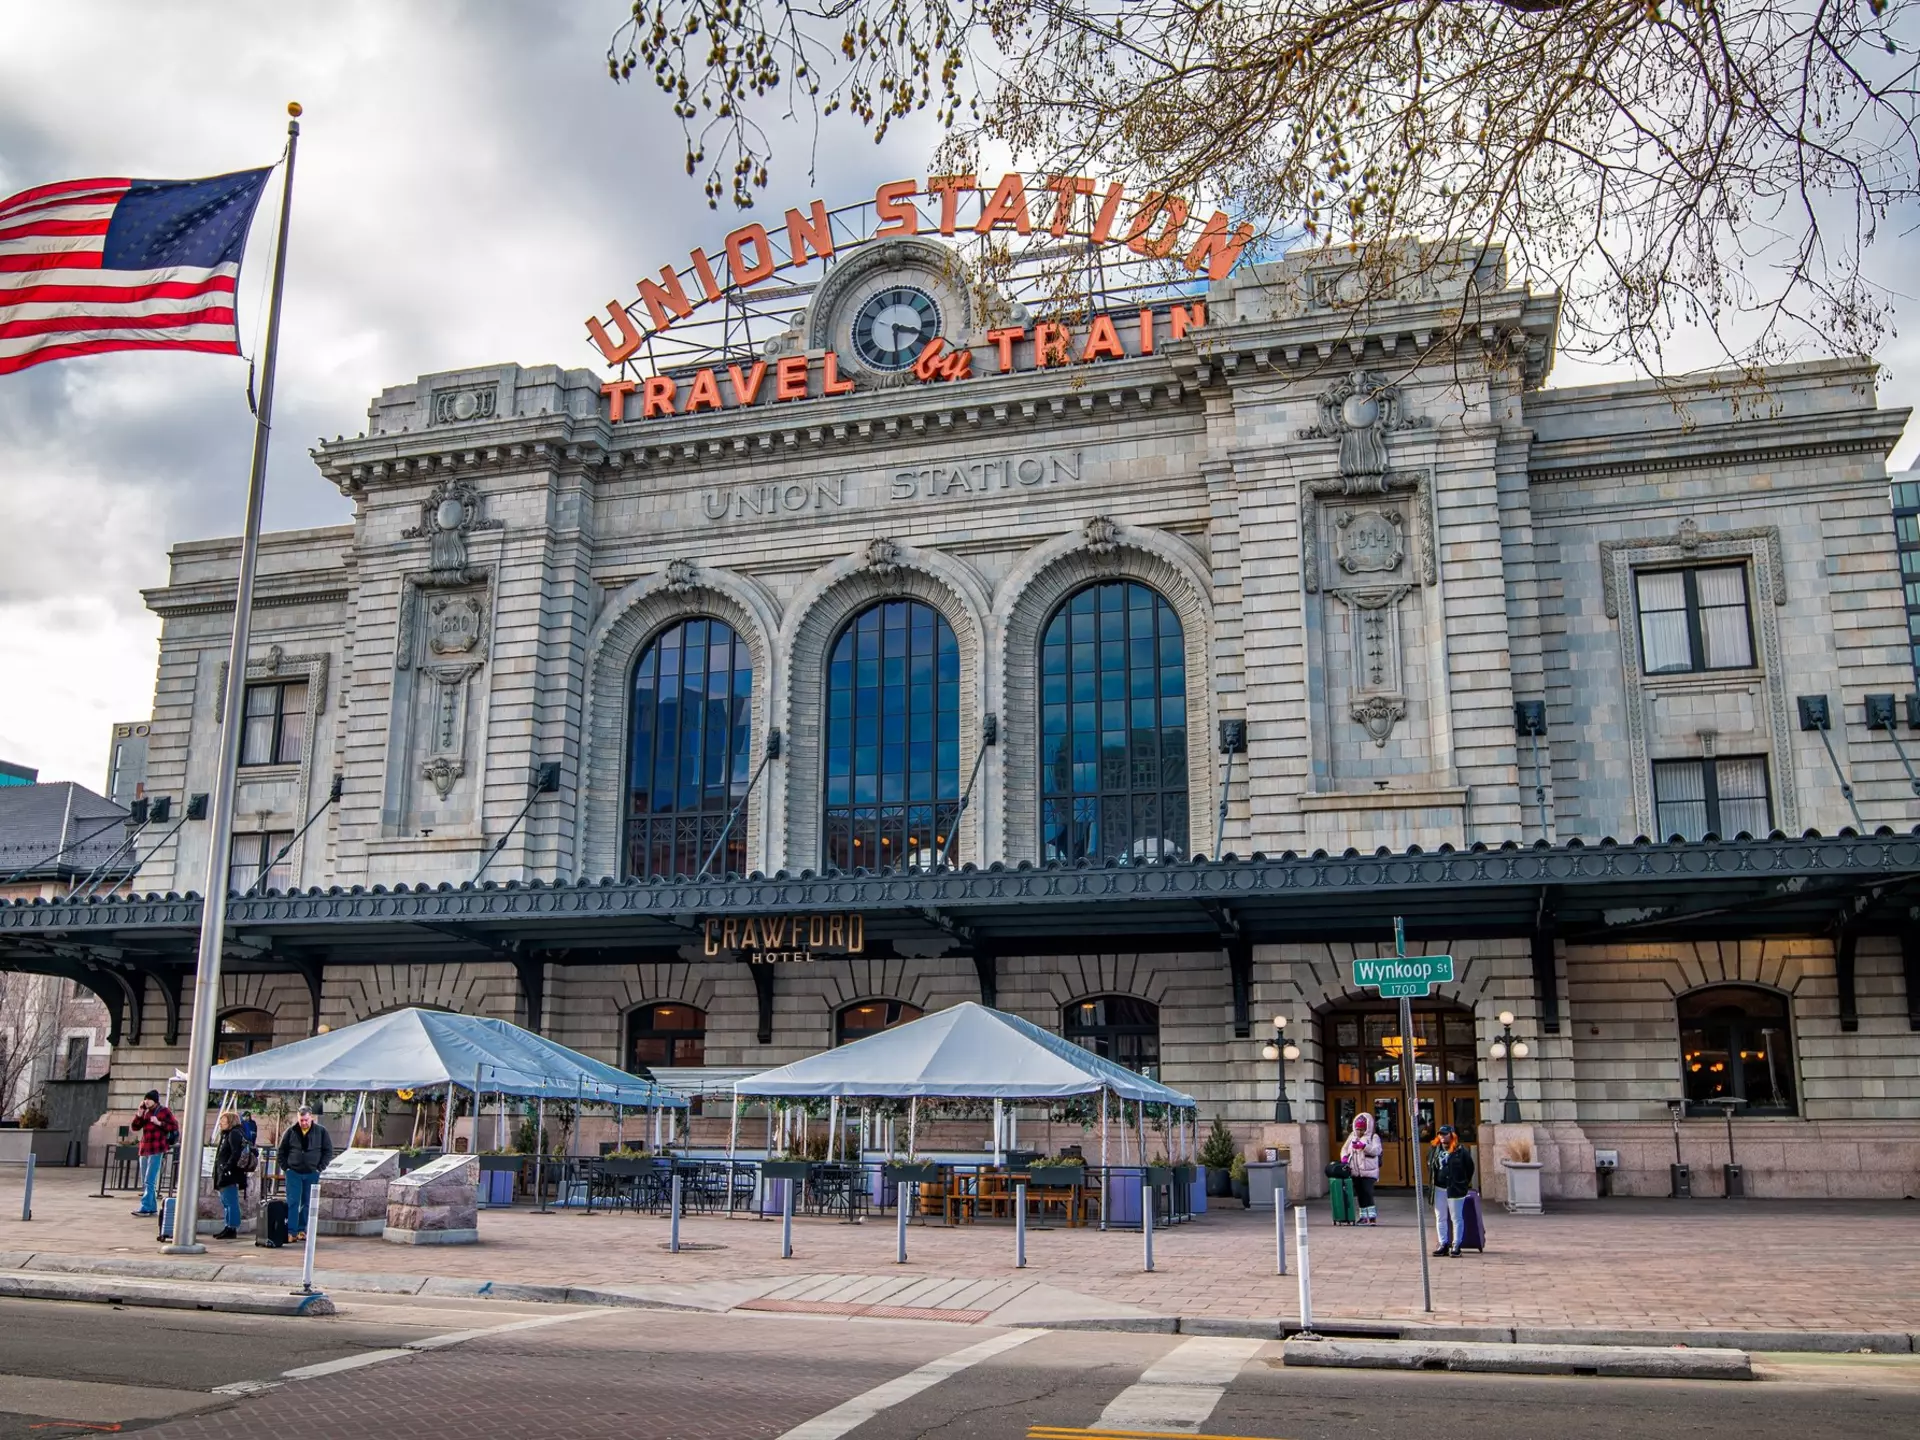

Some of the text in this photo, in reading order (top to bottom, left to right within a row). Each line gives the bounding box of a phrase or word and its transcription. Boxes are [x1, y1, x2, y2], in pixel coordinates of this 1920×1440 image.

[585, 198, 834, 365] UNION
[876, 173, 1254, 281] STATION
[601, 351, 855, 424] TRAVEL
[912, 336, 973, 381] by
[987, 301, 1207, 373] TRAIN
[702, 451, 1082, 520] UNION STATION
[1347, 524, 1391, 551] 1914
[439, 615, 470, 634] 1880
[704, 913, 864, 956] CRAWFORD
[752, 951, 814, 964] HOTEL
[1360, 961, 1448, 981] Wynkoop St
[1391, 985, 1417, 995] 1700
